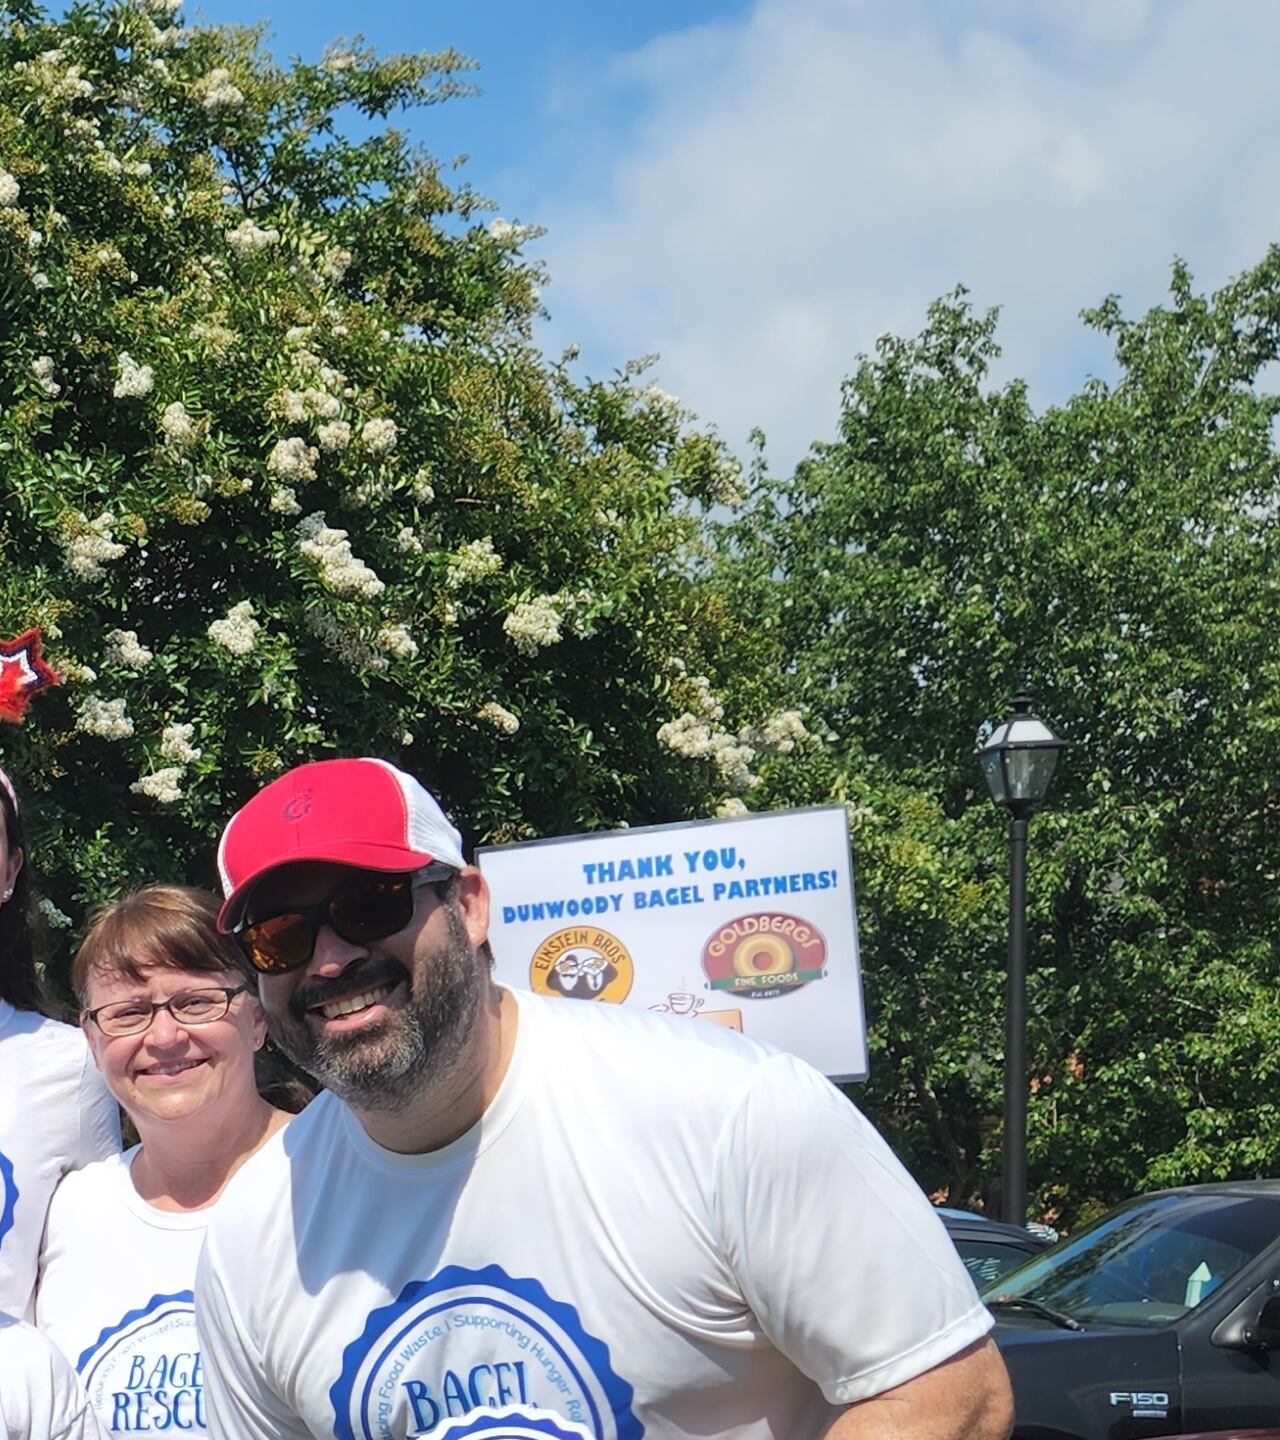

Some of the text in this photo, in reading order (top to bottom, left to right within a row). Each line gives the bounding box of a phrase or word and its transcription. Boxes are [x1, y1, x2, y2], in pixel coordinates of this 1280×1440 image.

[583, 847, 745, 885] THANK YOU,
[503, 870, 837, 924] DUNWOODY BAGEL PARTNERS!
[534, 930, 626, 971] EINSTEIN BROS
[708, 916, 820, 957] GOLDBERGS
[125, 1352, 204, 1390] BAGE
[379, 1361, 404, 1399] Food
[400, 1325, 443, 1361] Waste
[453, 1314, 531, 1349] Supporting
[530, 1342, 572, 1396] Hunger
[111, 1389, 208, 1431] RESCU
[401, 1360, 538, 1433] BAGEL
[1109, 1392, 1169, 1406] F150
